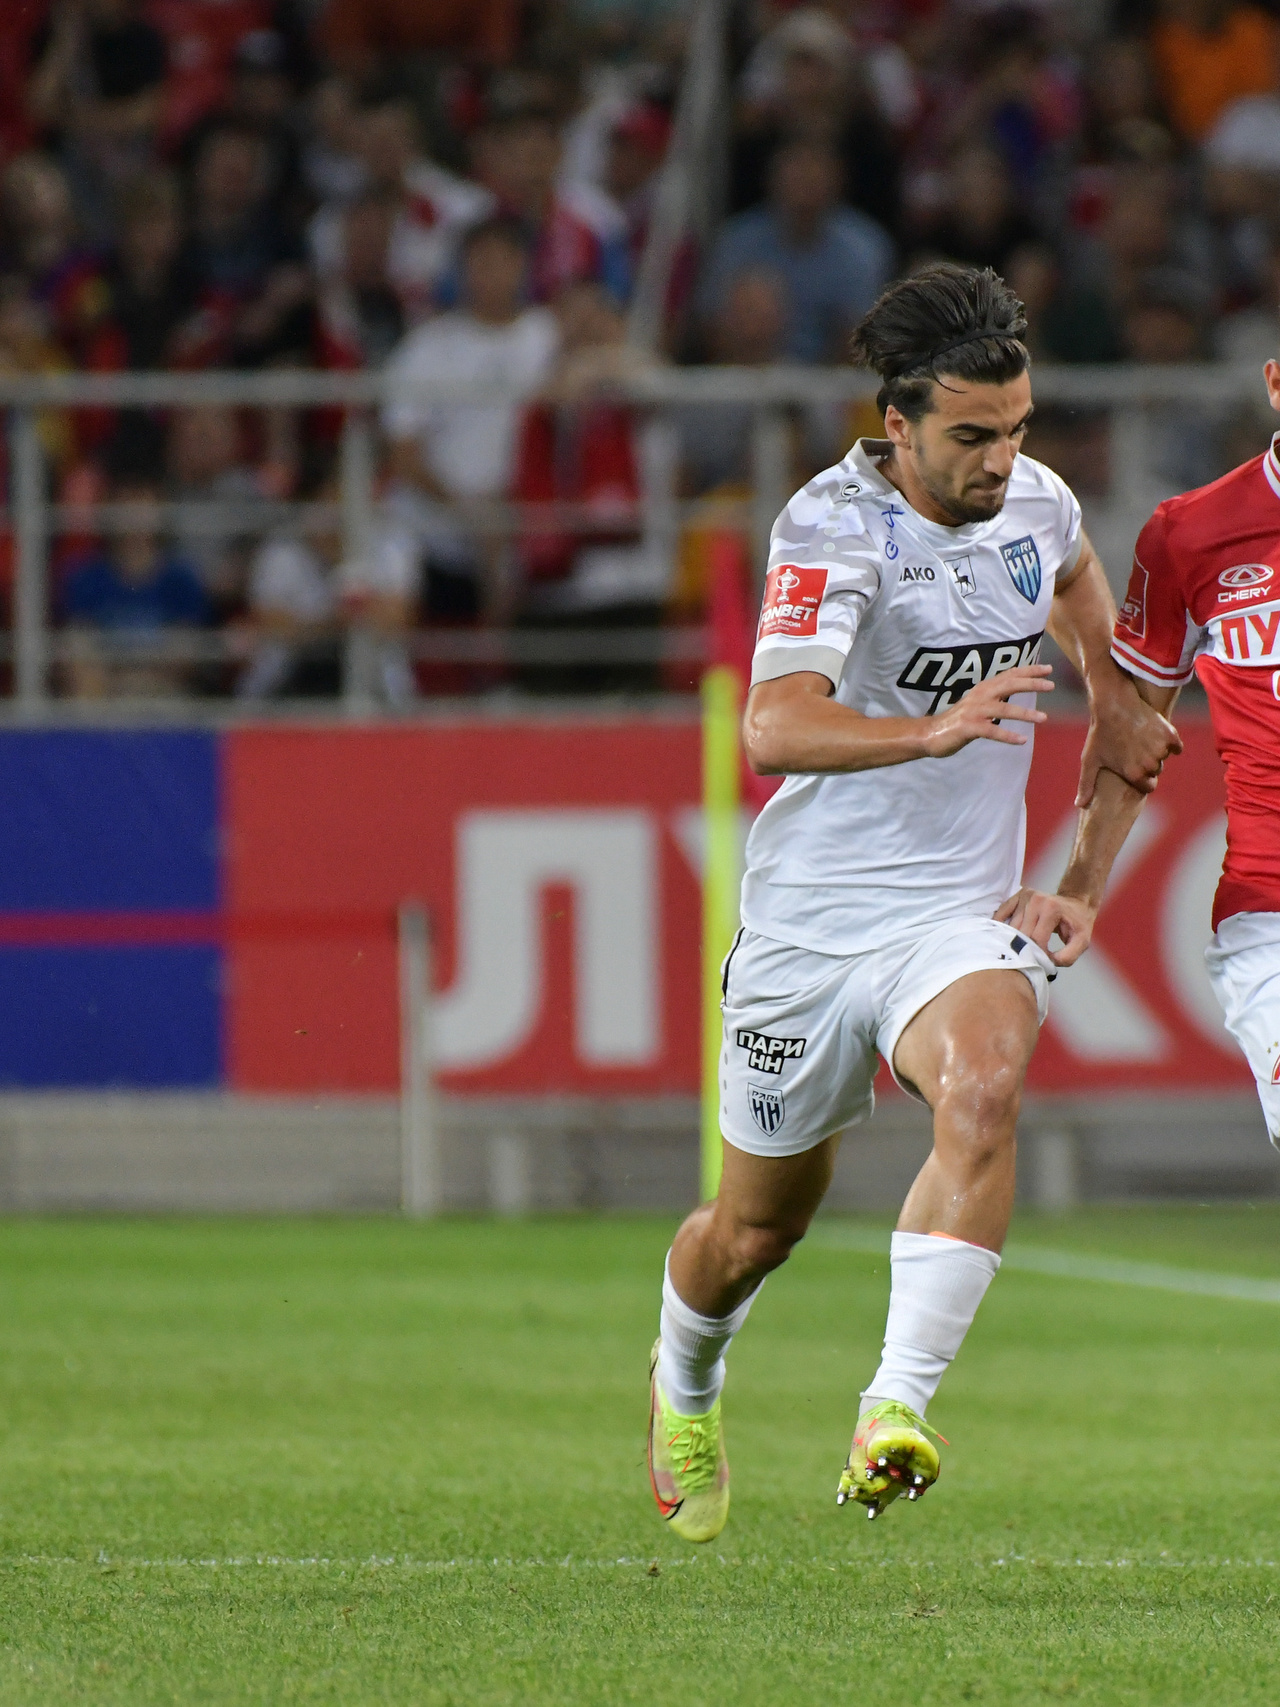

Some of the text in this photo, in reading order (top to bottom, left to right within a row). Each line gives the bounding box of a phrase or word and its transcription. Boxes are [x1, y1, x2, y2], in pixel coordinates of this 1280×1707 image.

[1004, 540, 1032, 560] PARI
[1217, 585, 1271, 603] CHERY
[738, 1031, 804, 1057] ПАРИ
